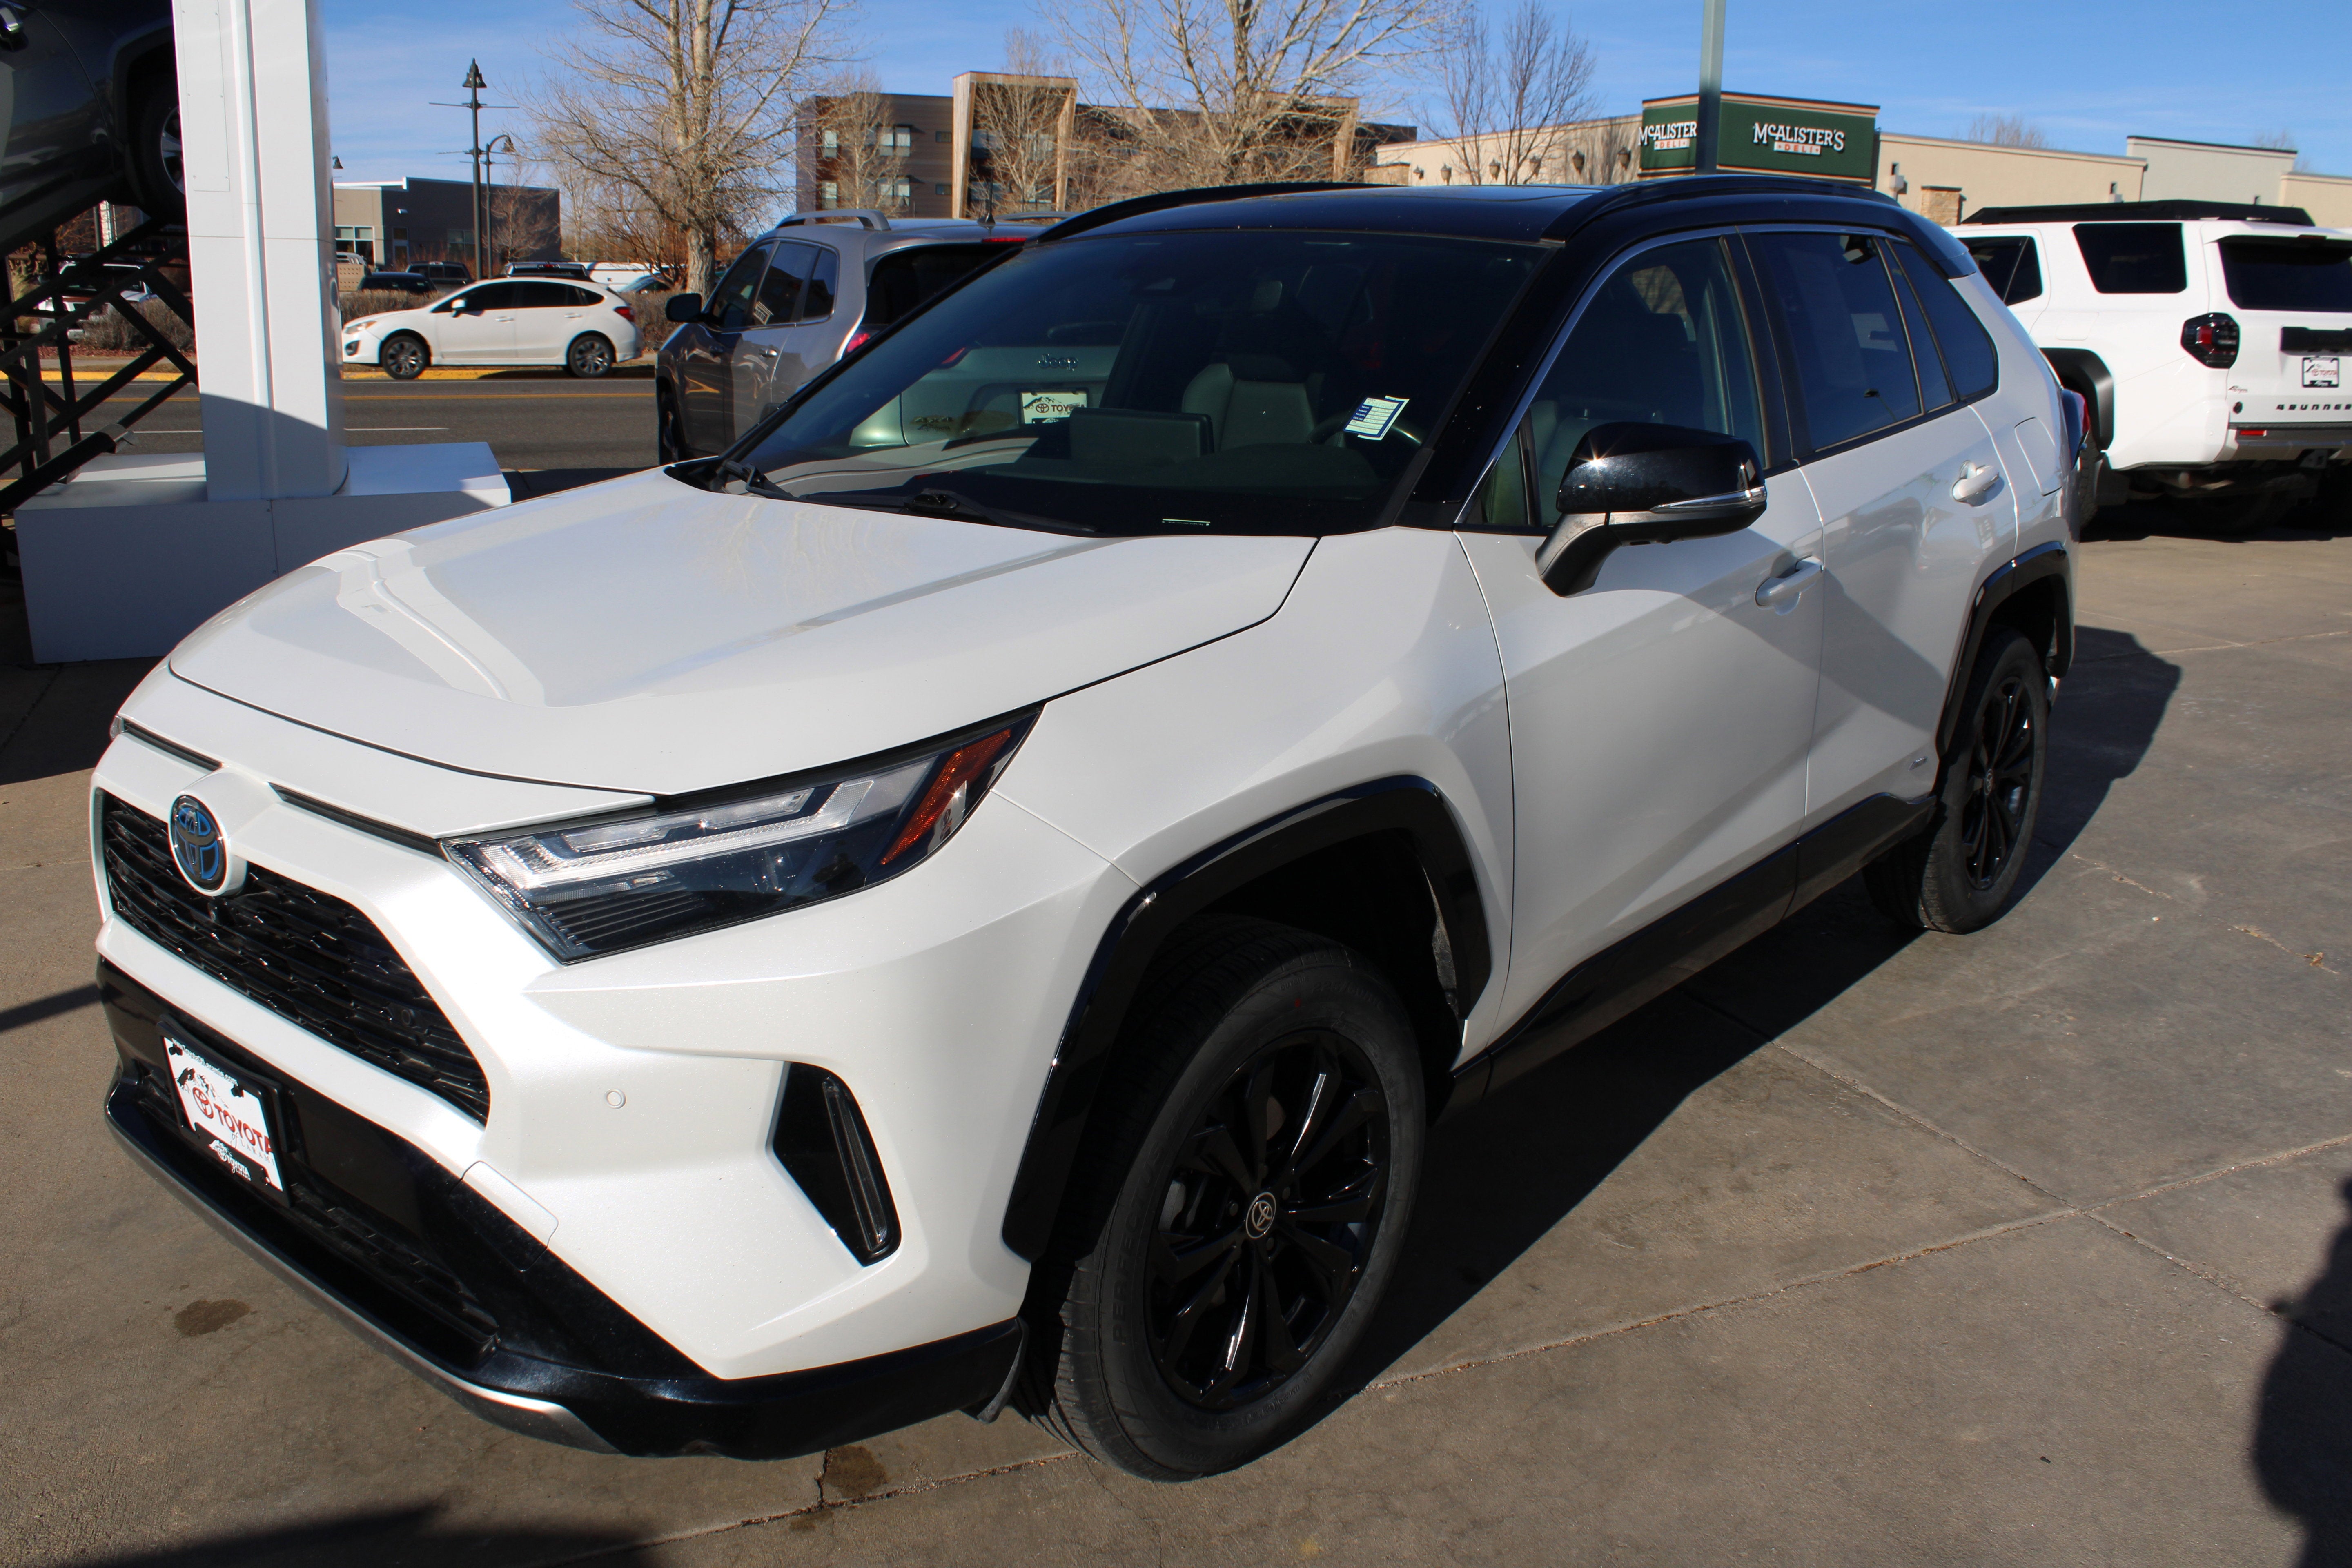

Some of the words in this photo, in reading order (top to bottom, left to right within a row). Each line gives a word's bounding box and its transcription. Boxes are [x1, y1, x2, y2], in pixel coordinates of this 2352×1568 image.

[1784, 144, 1813, 153] DELI
[1037, 353, 1078, 371] Jeep
[213, 1102, 273, 1155] TOYOTA
[241, 1139, 275, 1166] LARAMI
